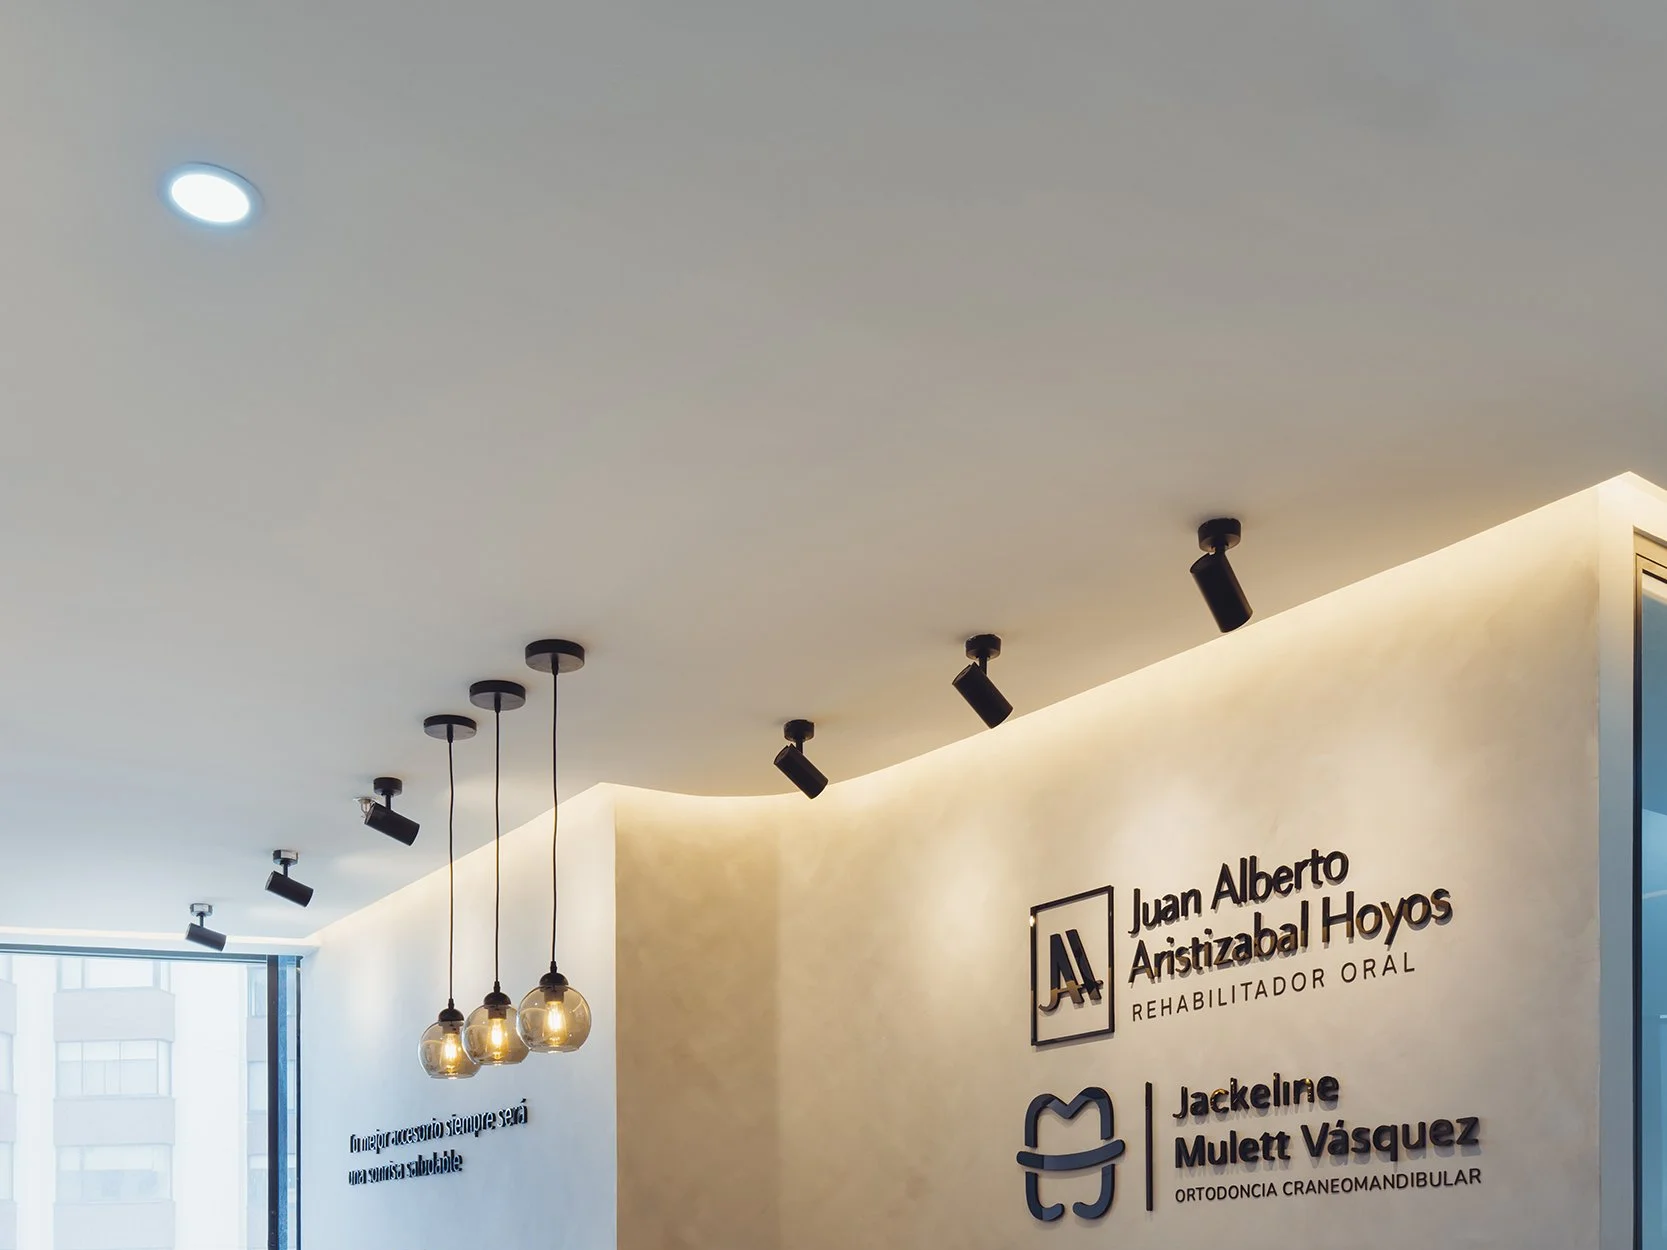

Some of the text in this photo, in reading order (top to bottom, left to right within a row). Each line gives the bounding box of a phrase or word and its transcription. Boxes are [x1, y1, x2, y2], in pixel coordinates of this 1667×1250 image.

[1128, 848, 1349, 936] Juan Alberto
[1128, 888, 1454, 984] Aristizabal Hoyos
[1131, 951, 1416, 1022] REHABILITADOR ORAL
[1172, 1072, 1340, 1120] Jackeline
[361, 1128, 391, 1155] mejor
[391, 1117, 445, 1148] accesorio
[445, 1113, 497, 1138] siempre
[497, 1097, 529, 1128] será
[1174, 1116, 1480, 1169] Mulett Vásquez
[348, 1167, 367, 1186] una
[367, 1160, 405, 1184] sonrisa
[1174, 1167, 1482, 1203] ORTODONCIA CRANEOMANDIBULAR
